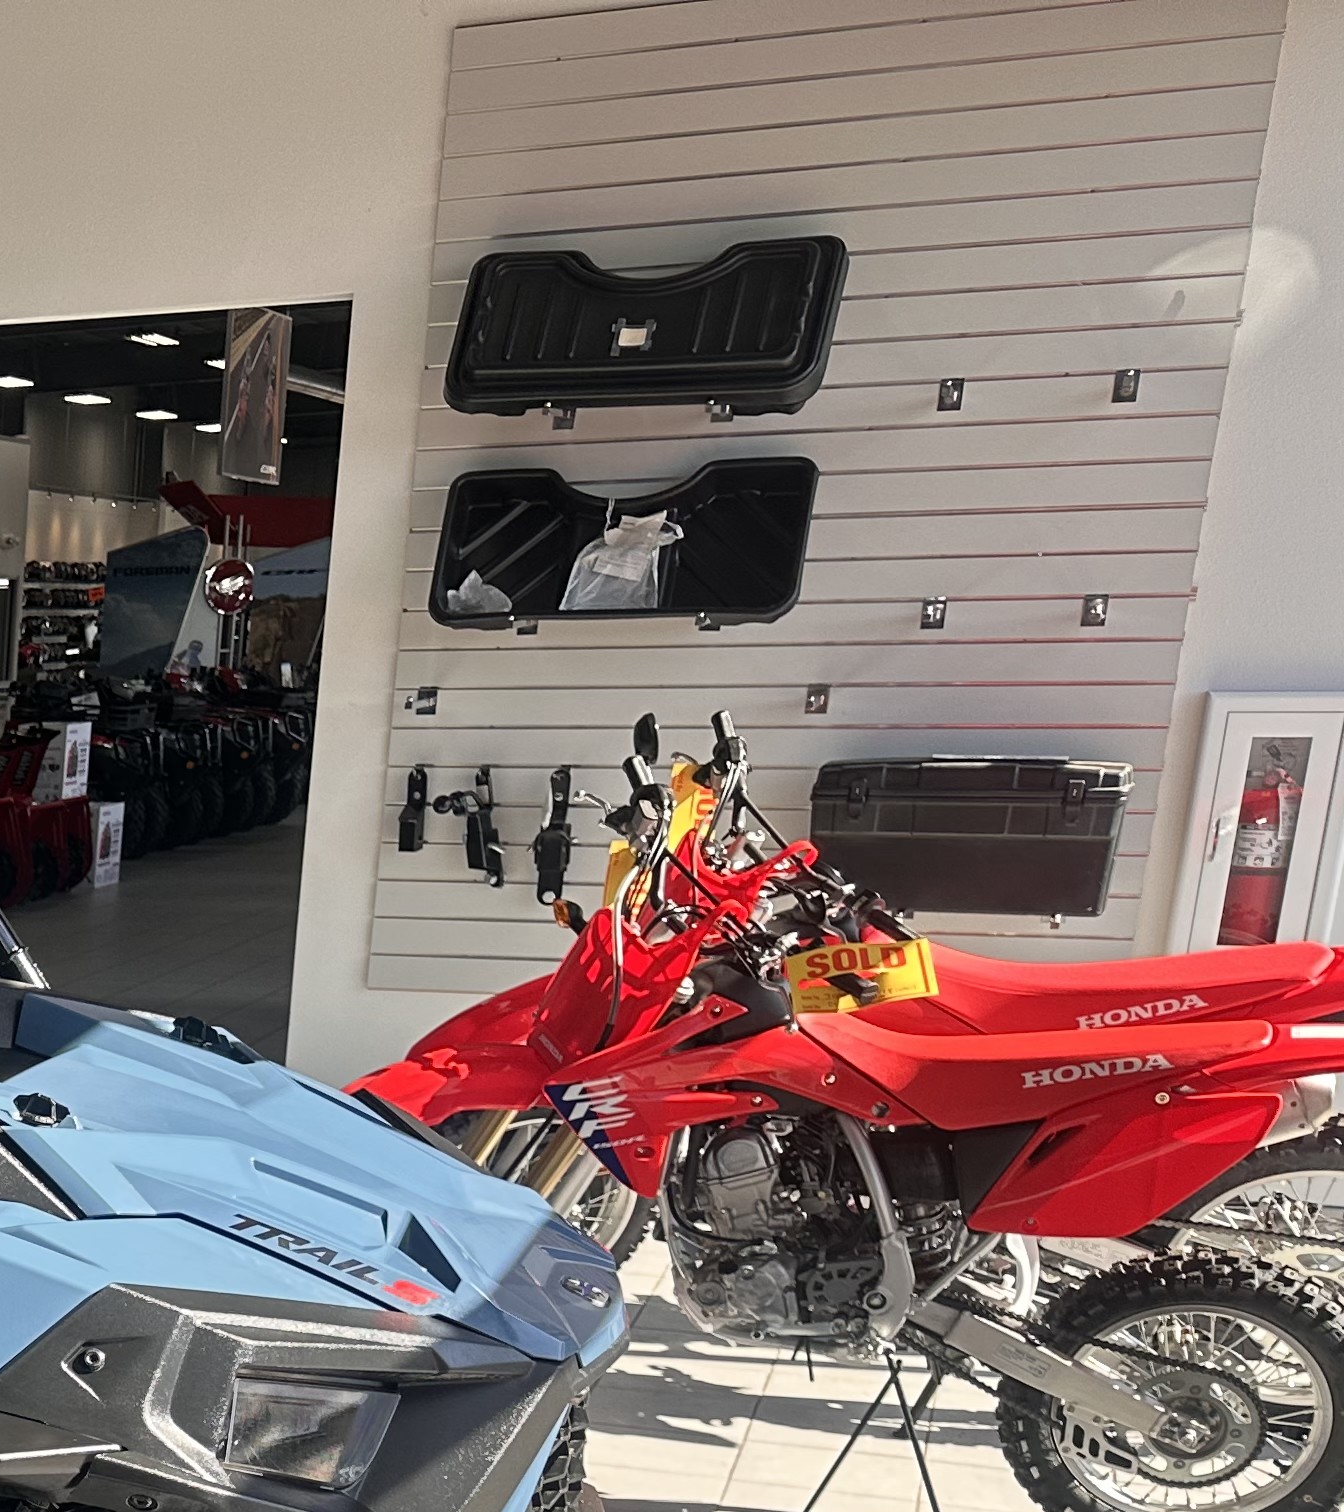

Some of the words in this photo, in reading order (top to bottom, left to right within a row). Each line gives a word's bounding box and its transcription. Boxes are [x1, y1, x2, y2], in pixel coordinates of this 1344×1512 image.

[113, 565, 191, 577] FOREMAN
[805, 946, 907, 979] SOLD
[1076, 994, 1209, 1031] HONDA
[1020, 1053, 1175, 1089] HONDA
[561, 1073, 636, 1140] CRF
[228, 1212, 381, 1286] TRAIL
